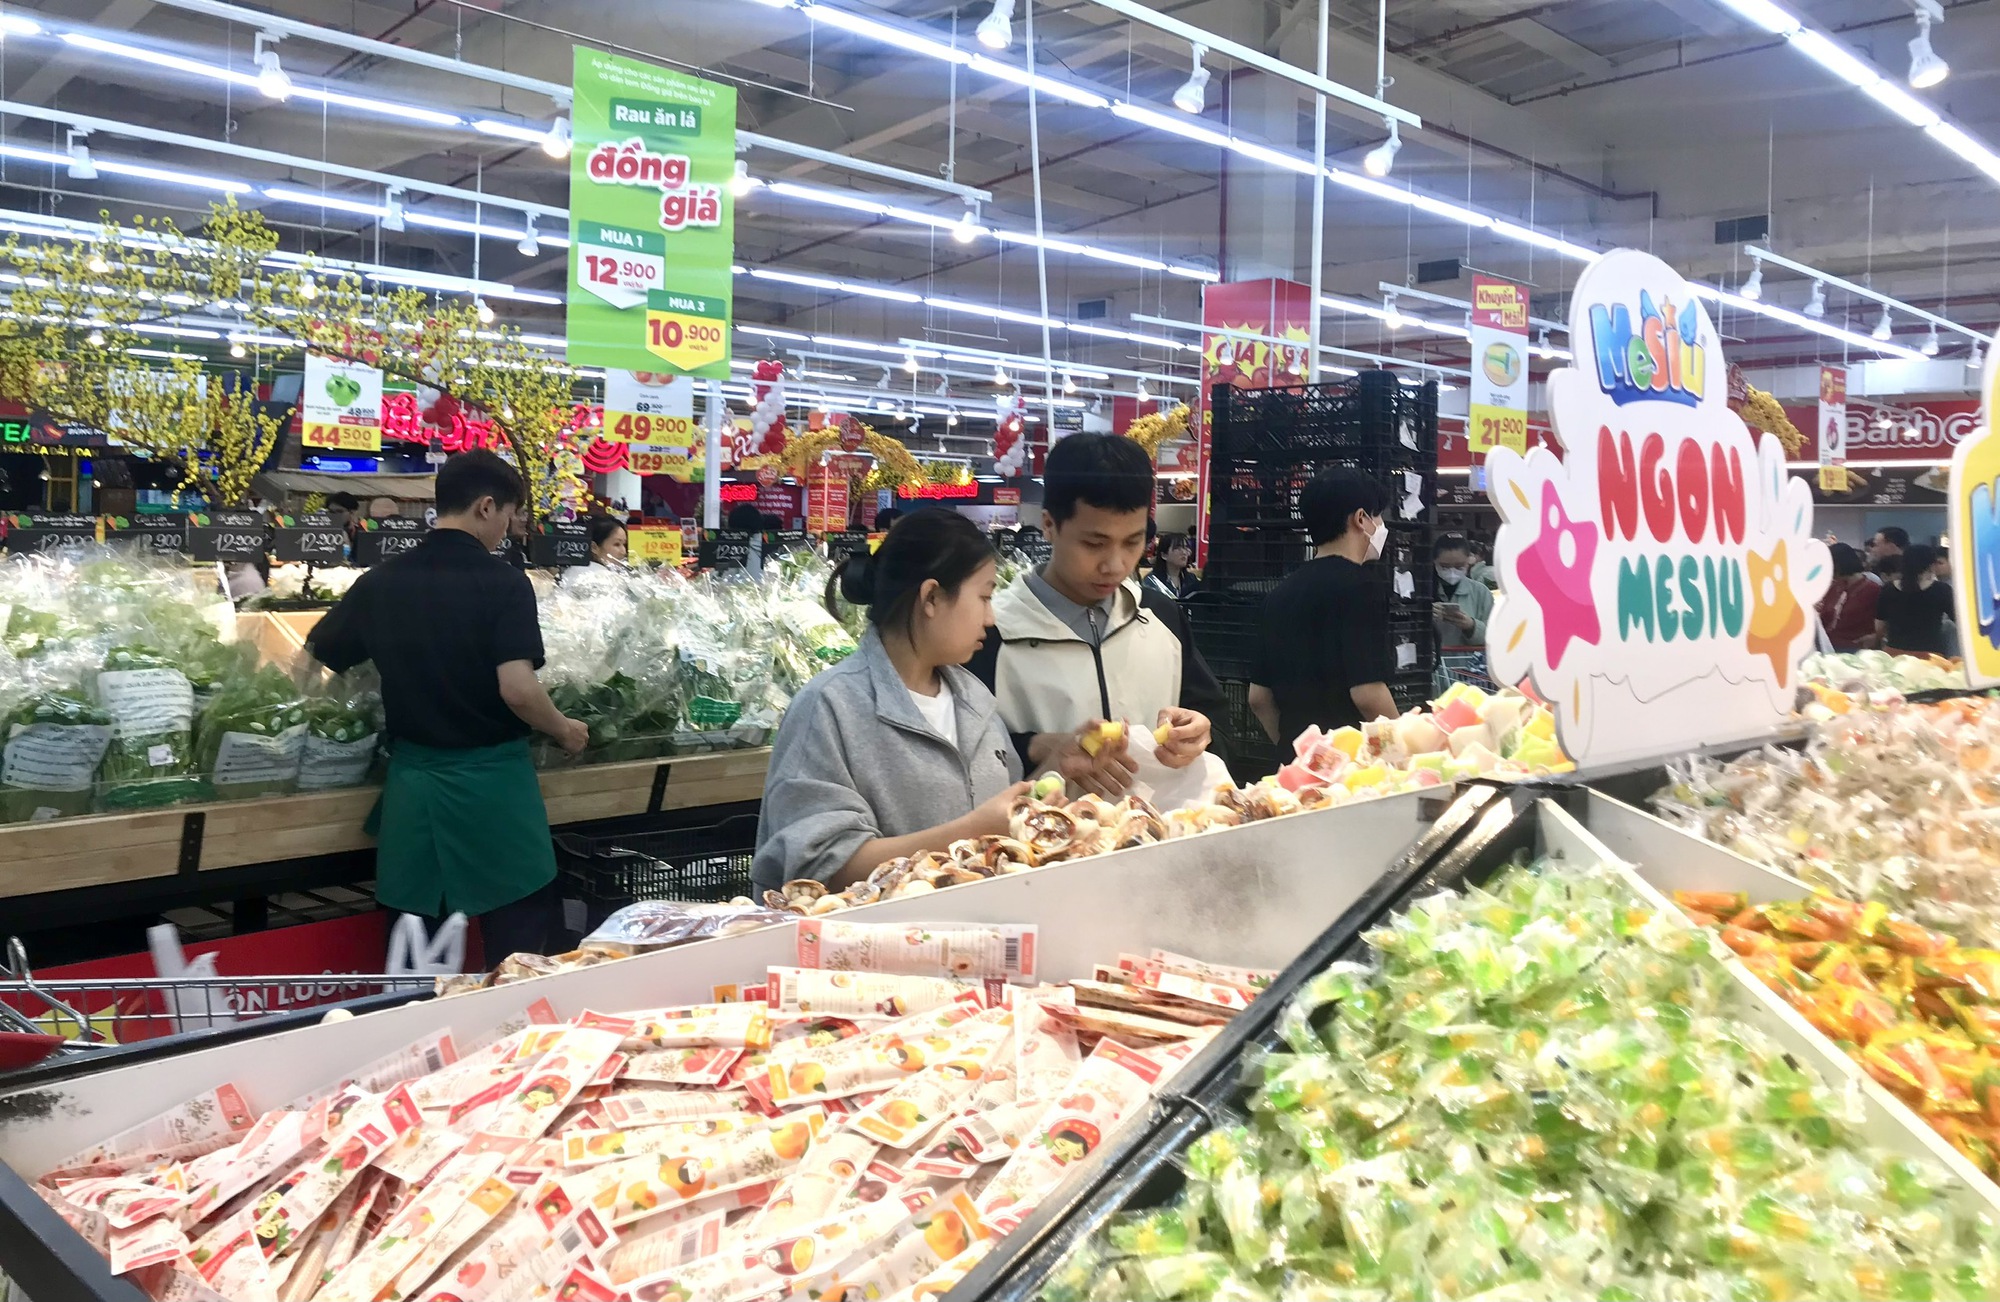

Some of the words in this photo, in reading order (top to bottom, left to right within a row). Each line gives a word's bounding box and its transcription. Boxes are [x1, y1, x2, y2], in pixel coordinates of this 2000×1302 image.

[615, 104, 651, 124] Rau
[654, 107, 677, 127] ăn
[680, 110, 696, 129] lá
[590, 142, 687, 190] đồng
[663, 189, 718, 226] giá
[600, 228, 634, 247] MUA
[636, 234, 644, 248] 1
[585, 255, 656, 286] 12.900
[669, 297, 696, 311] MUA
[698, 301, 706, 312] 3
[1479, 287, 1514, 307] Khuyến
[648, 318, 721, 348] 10.900
[614, 414, 687, 441] 49.900
[1480, 417, 1523, 446] 21.900
[1597, 424, 1746, 545] NGON
[1617, 553, 1744, 644] MESIU
